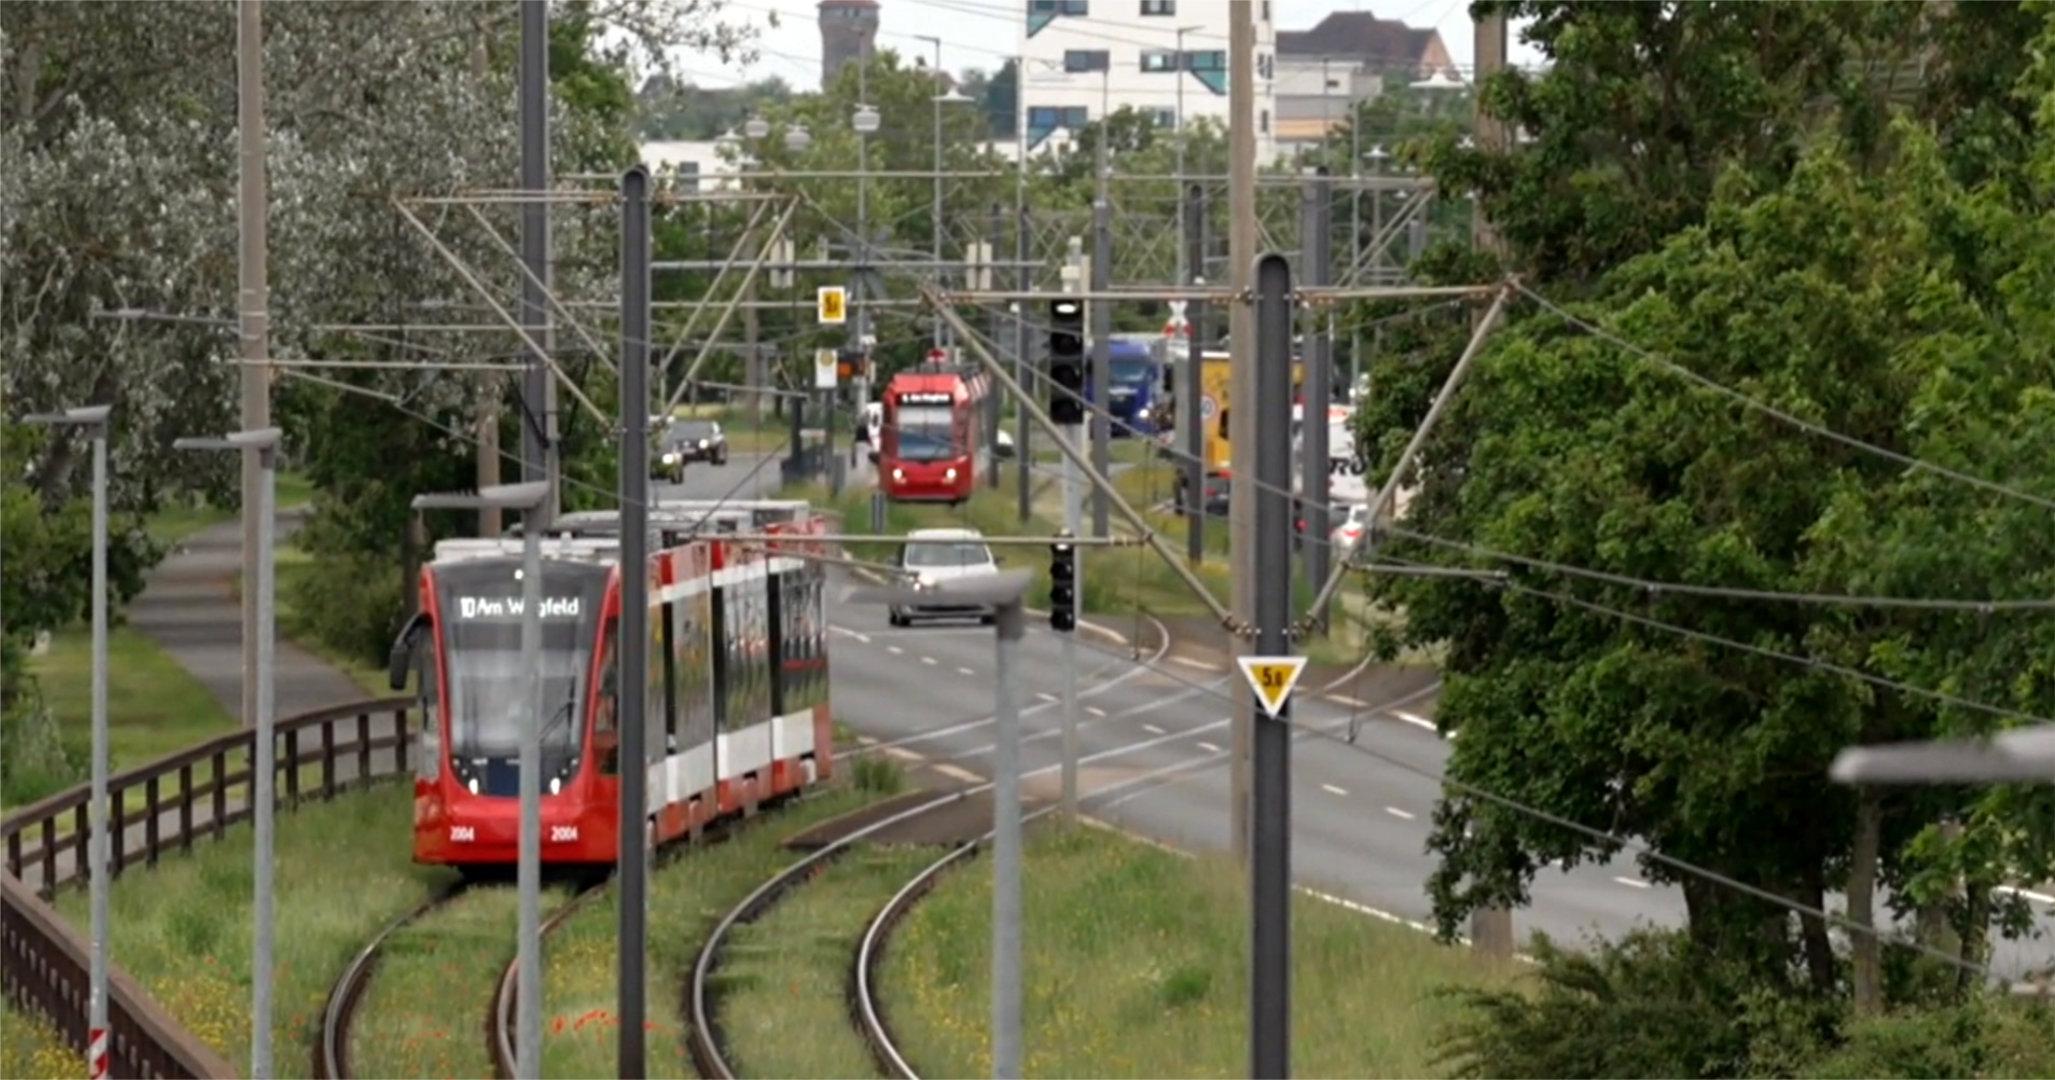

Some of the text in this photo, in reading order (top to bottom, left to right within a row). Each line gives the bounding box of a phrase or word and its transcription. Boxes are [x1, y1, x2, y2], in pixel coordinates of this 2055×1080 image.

[477, 597, 503, 615] Am
[507, 597, 579, 618] Wgfeld
[551, 825, 578, 842] 2004
